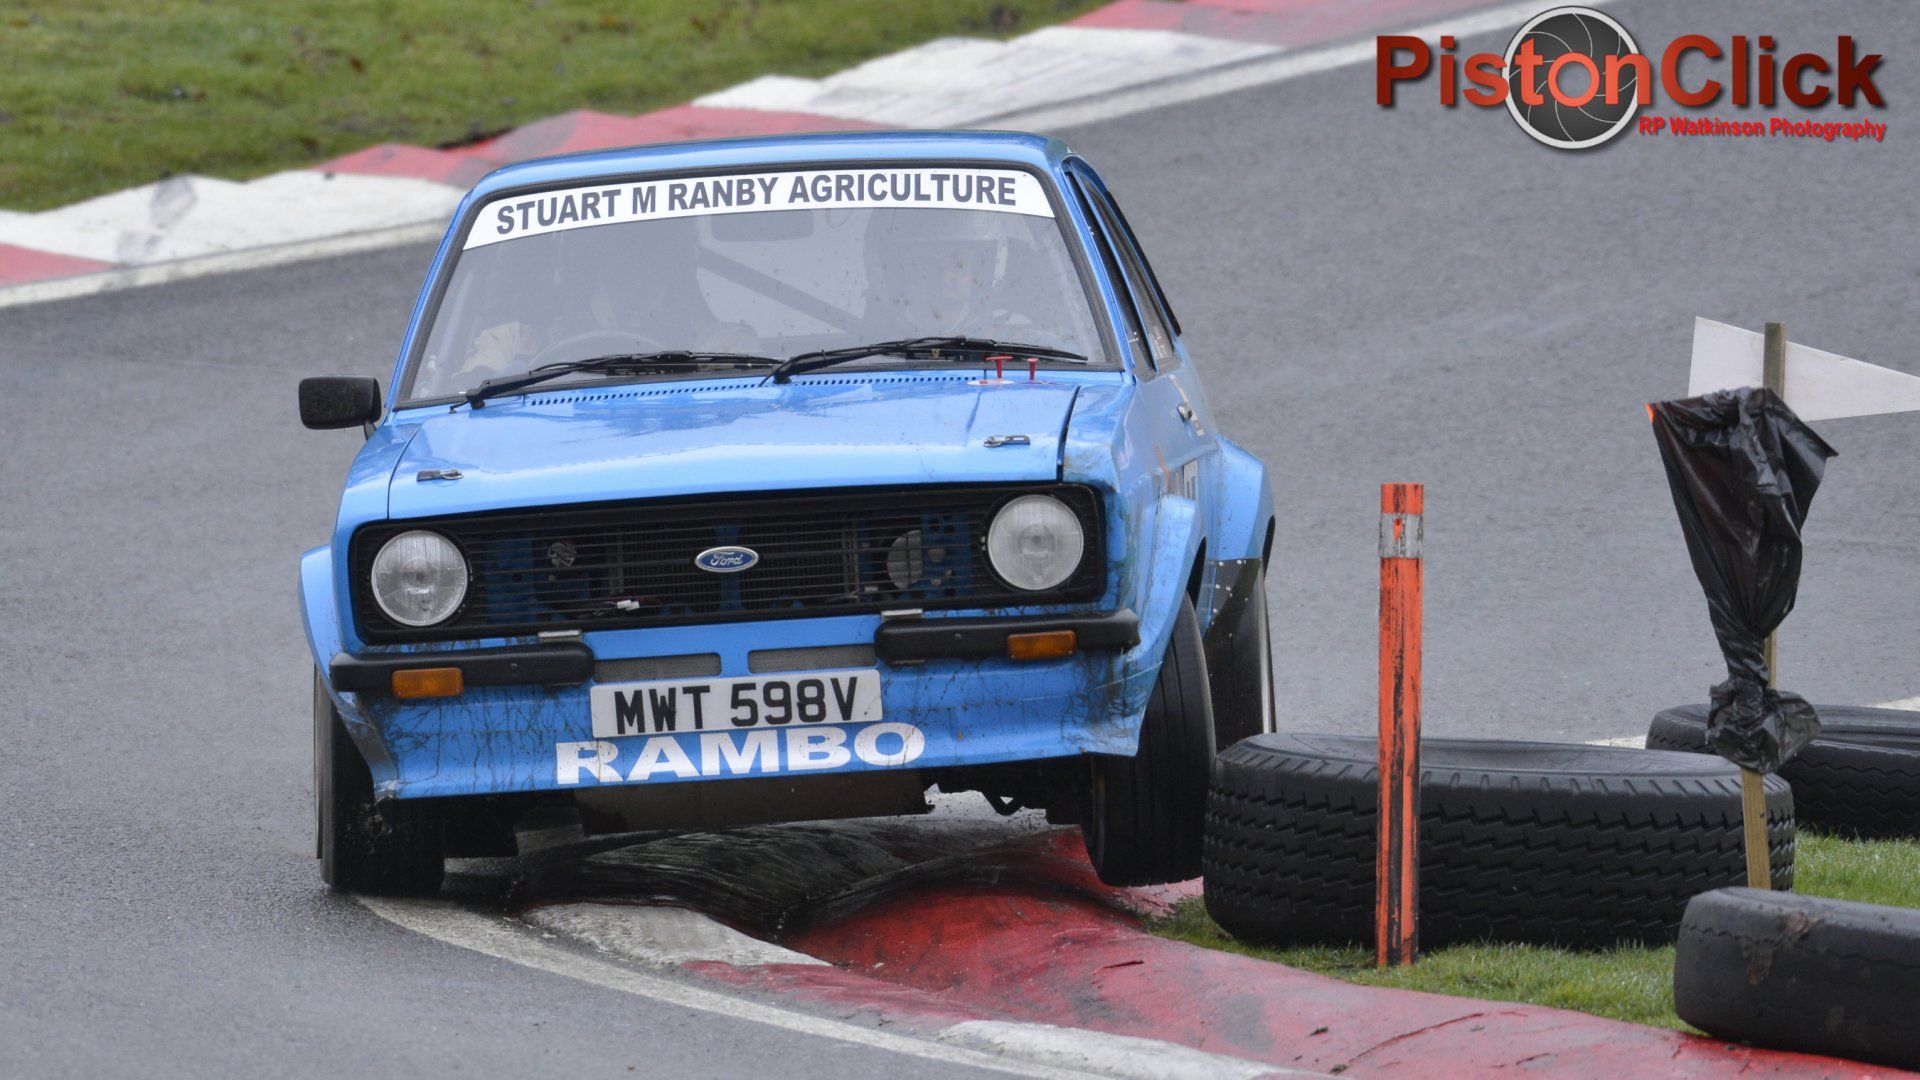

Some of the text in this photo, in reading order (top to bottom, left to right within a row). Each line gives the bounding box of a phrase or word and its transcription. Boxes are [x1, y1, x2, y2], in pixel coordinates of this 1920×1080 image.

[496, 173, 1017, 235] STUART M RANBY AGRICULTURE
[710, 551, 744, 567] Ford
[613, 676, 858, 735] MWT 598V
[555, 722, 925, 785] RAMBO
